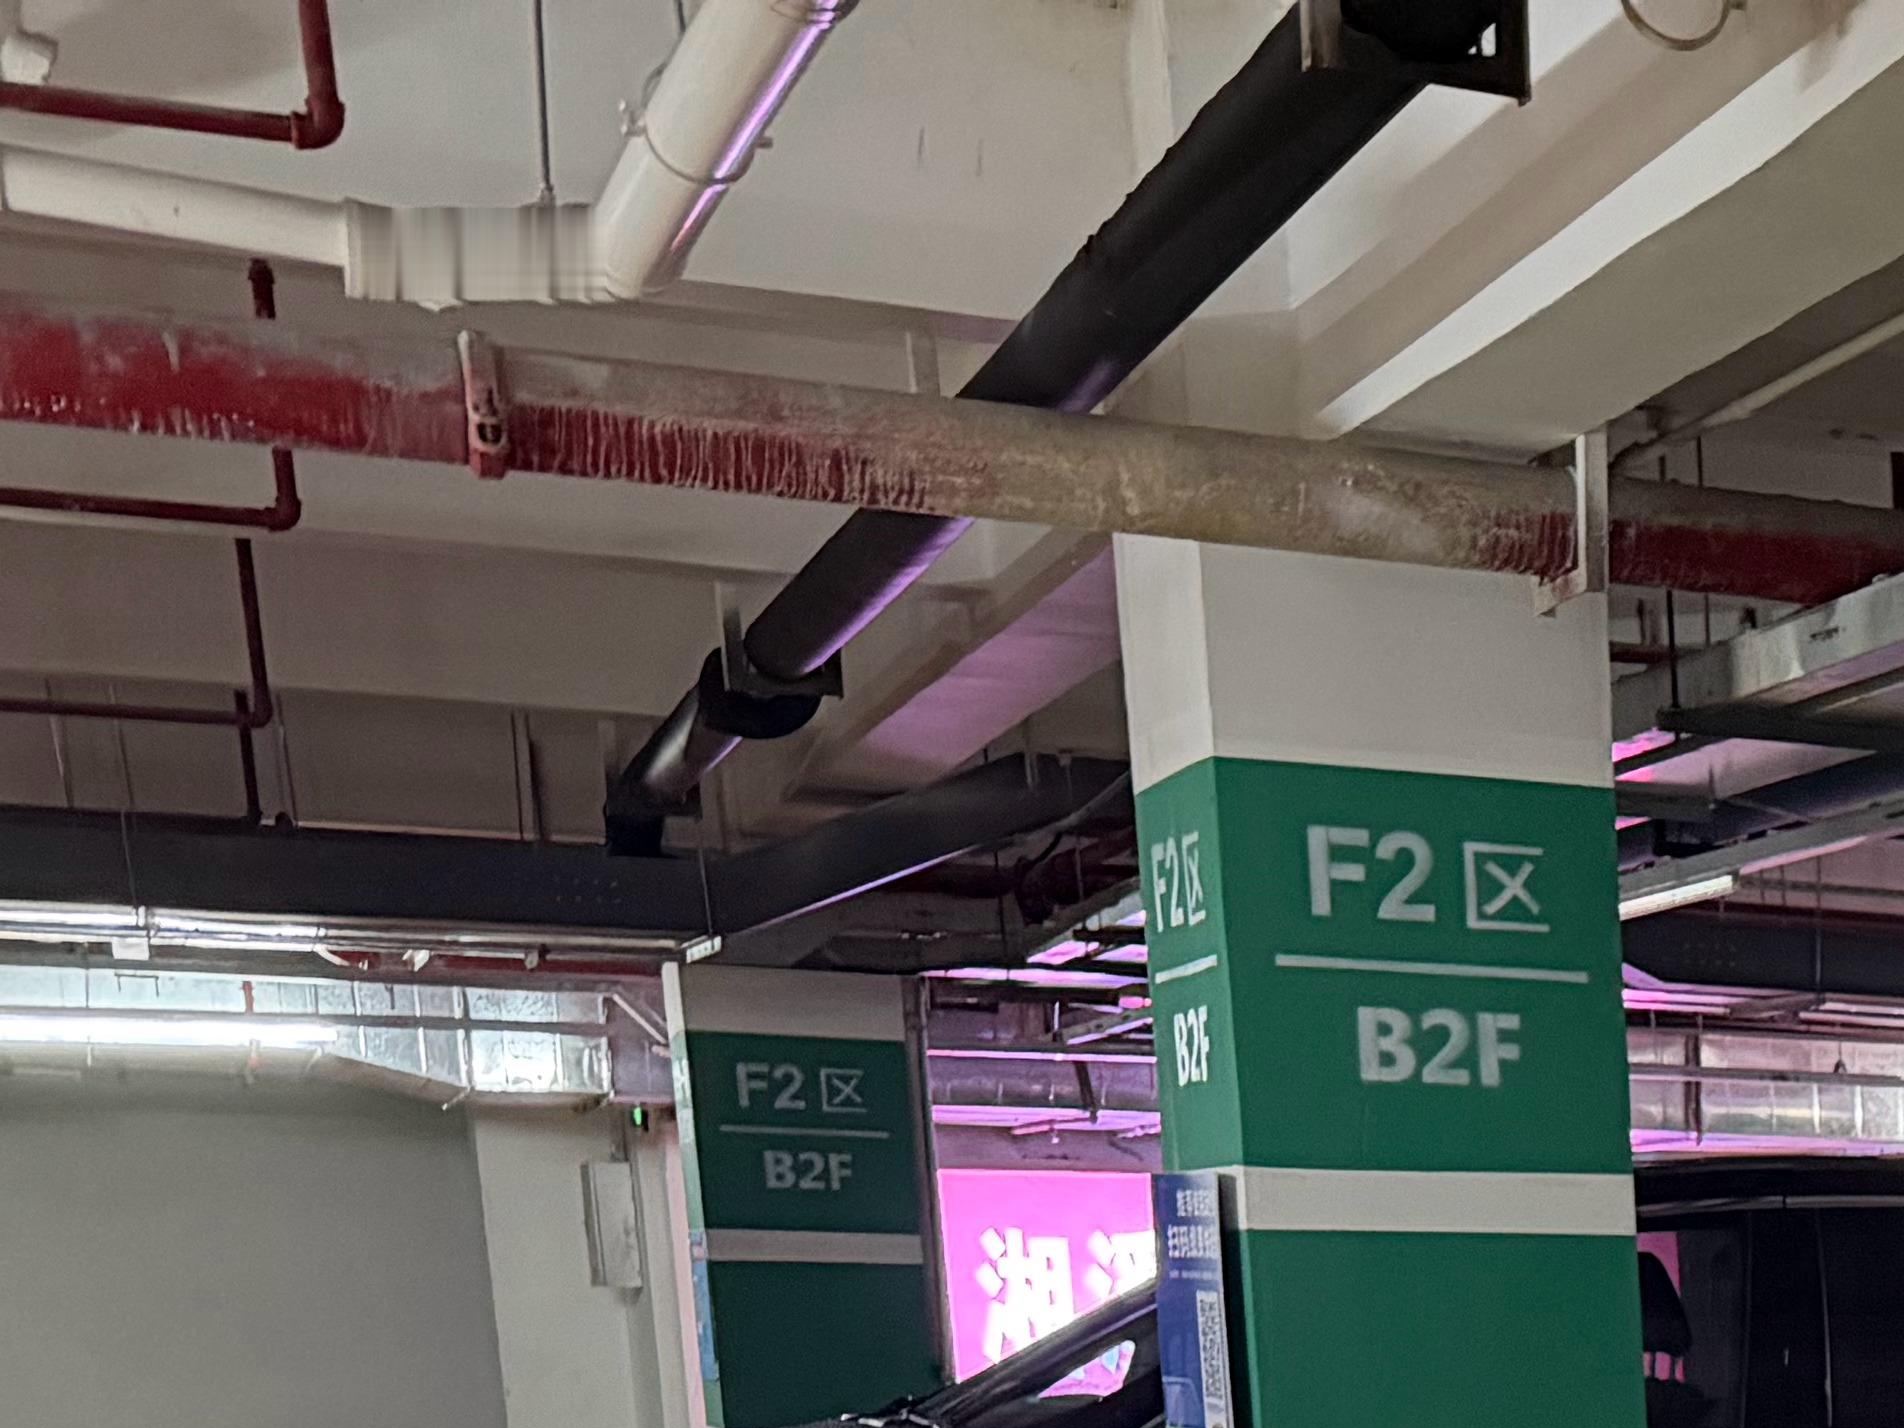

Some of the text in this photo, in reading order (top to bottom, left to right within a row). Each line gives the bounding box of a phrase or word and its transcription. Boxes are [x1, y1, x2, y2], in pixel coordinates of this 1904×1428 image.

[1174, 1004, 1209, 1087] B2F
[1357, 1005, 1521, 1087] B2F
[764, 1150, 852, 1192] B2F
